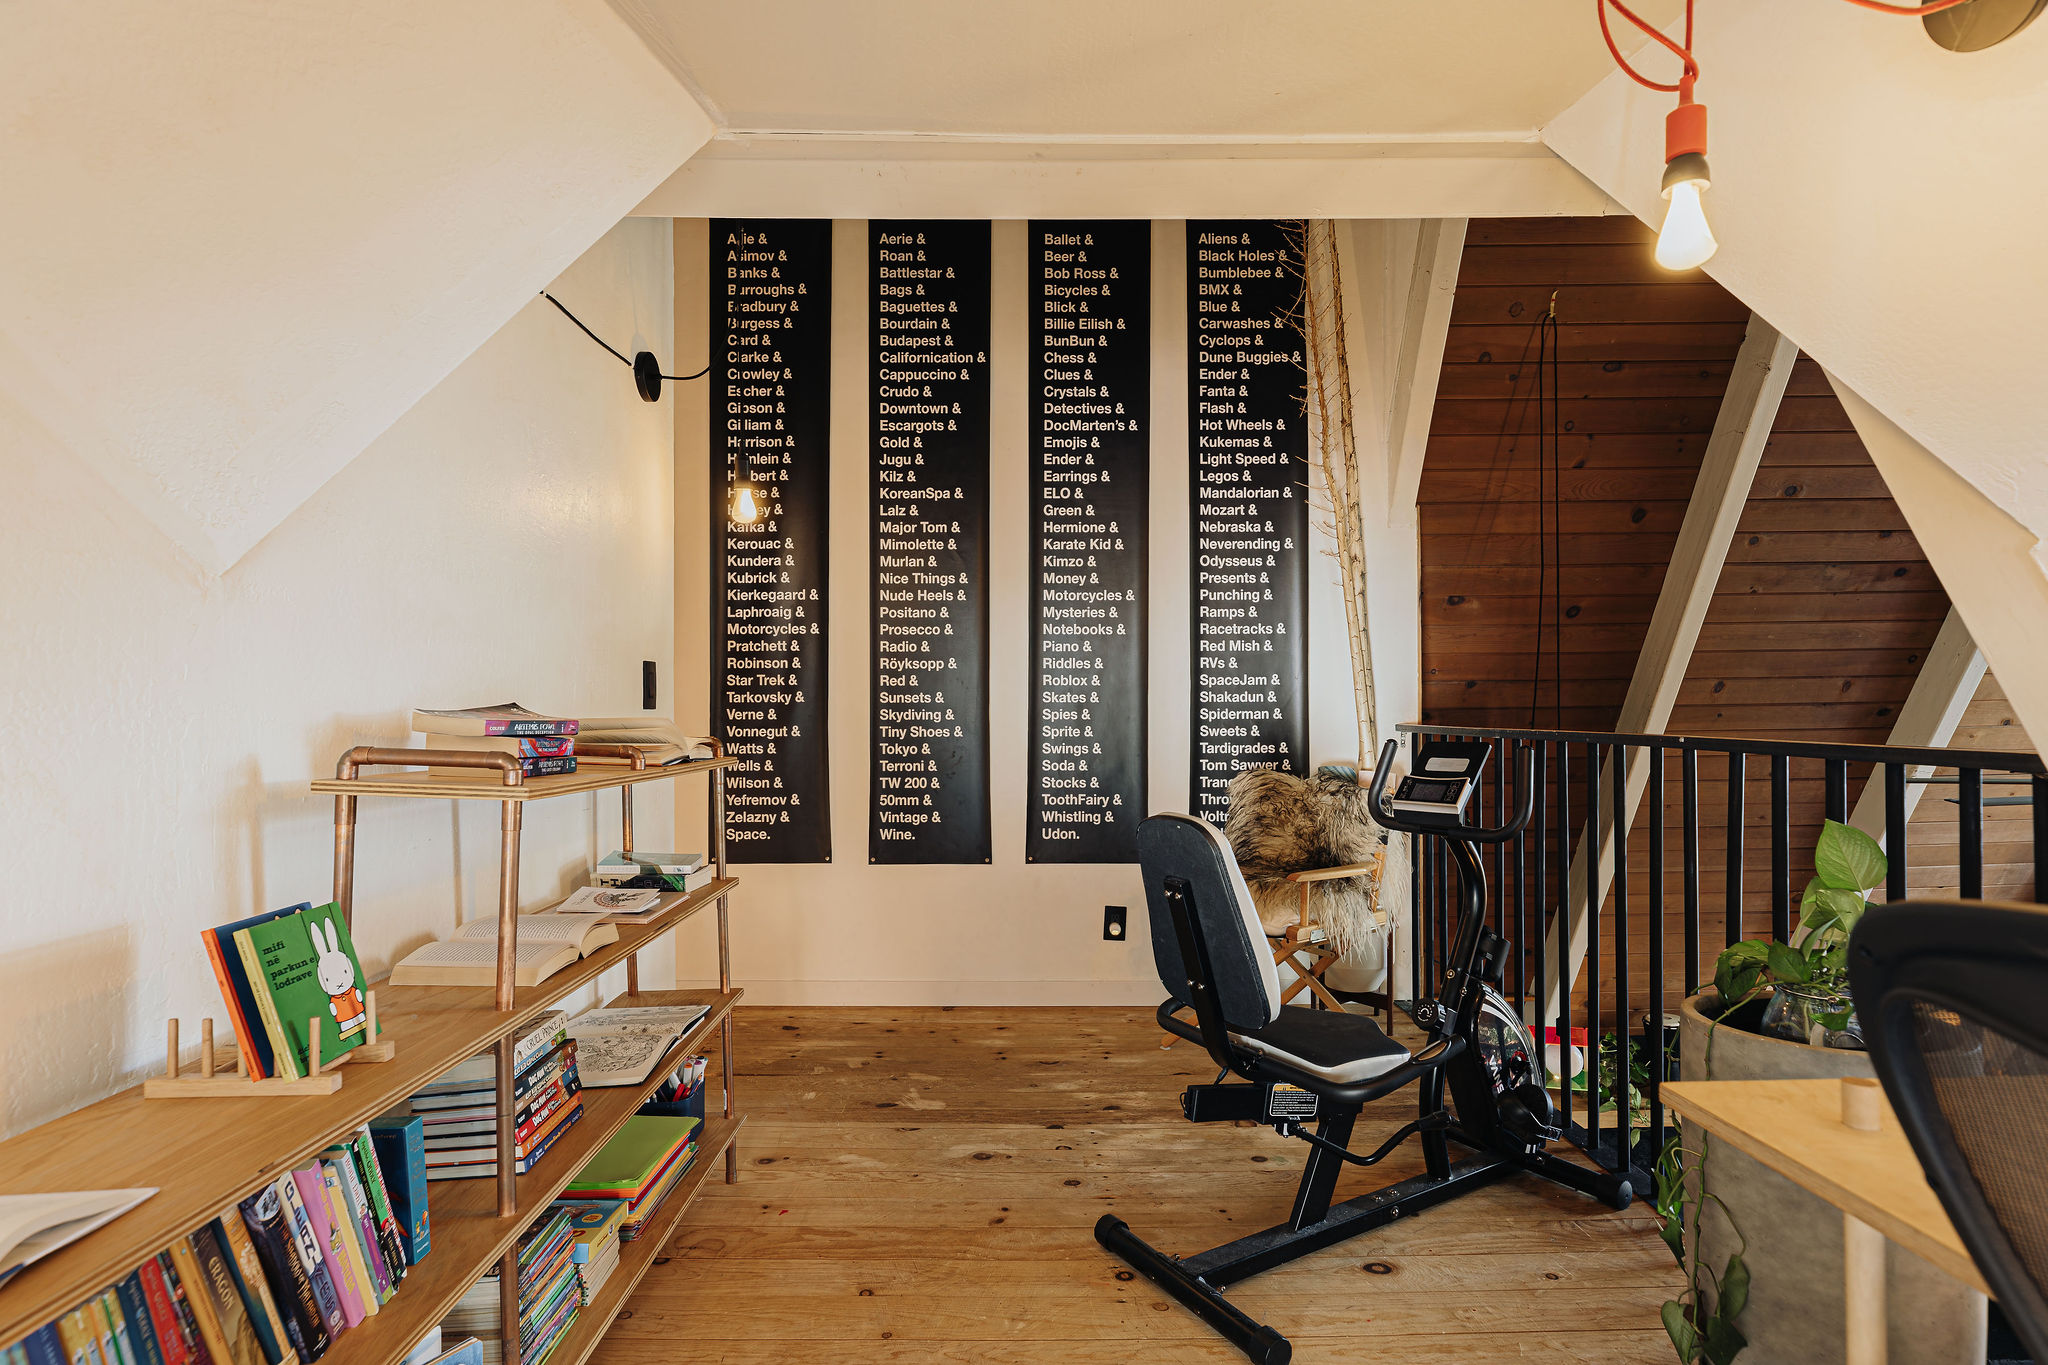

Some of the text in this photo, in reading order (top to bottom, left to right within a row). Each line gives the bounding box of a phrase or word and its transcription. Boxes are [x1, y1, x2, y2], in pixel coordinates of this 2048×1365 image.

[880, 233, 926, 244] Aerie &
[1045, 234, 1093, 245] Ballet &
[1199, 233, 1250, 244] Aliens &
[771, 267, 780, 278] &
[880, 267, 955, 278] Battlestar &
[1045, 268, 1119, 279] Bob Ross &
[1200, 284, 1242, 295] BMX &
[880, 301, 958, 314] Baguettes &
[1045, 318, 1126, 329] Billie Eilish &
[1199, 335, 1264, 348] Cyclops &
[880, 352, 986, 363] Californication &
[1200, 351, 1302, 365] Dune Buggies &
[783, 368, 792, 379] &
[776, 385, 784, 396] &
[1044, 386, 1109, 399] Crystals &
[880, 403, 961, 414] Downtown &
[1044, 403, 1125, 414] Detectives &
[1200, 419, 1285, 430] Hot Wheels &
[1200, 436, 1272, 447] Kukemas &
[879, 454, 924, 467] Jugu &
[880, 487, 963, 501] KoreanSpa &
[1044, 488, 1084, 499] ELO &
[1200, 487, 1292, 498] Mandalorian &
[728, 538, 794, 549] Kerouac &
[880, 539, 957, 550] Mimolette &
[1044, 539, 1124, 550] Karate Kid &
[1200, 555, 1275, 569] Odysseus &
[728, 572, 790, 583] Kubrick &
[880, 573, 968, 586] Nice Things &
[728, 589, 818, 602] Kierkegaard &
[1044, 607, 1118, 620] Mysteries &
[728, 623, 819, 636] Motorcycles &
[881, 658, 957, 671] Röyksopp &
[1201, 657, 1238, 668] RVs &
[727, 674, 797, 686] Star Trek &
[1043, 675, 1100, 686] Roblox &
[727, 691, 805, 705] Tarkovsky &
[1200, 691, 1277, 702] Shakadun &
[880, 709, 954, 722] Skydiving &
[727, 725, 801, 739] Vonnegut &
[1042, 726, 1093, 739] Sprite &
[1200, 759, 1227, 770] Tom
[1282, 759, 1291, 770] &
[726, 777, 783, 788] Wilson &
[880, 777, 940, 788] TW 200 &
[1042, 794, 1122, 807] ToothFairy &
[726, 811, 790, 825] Zelazny &
[1200, 811, 1229, 822] Voltr
[726, 829, 770, 842] Space.
[880, 829, 915, 840] Wine.
[1042, 828, 1079, 839] Udon.
[262, 940, 286, 955] mifi
[266, 955, 280, 968] në
[270, 956, 315, 981] parkun e
[273, 970, 313, 991] lodrave
[208, 1256, 235, 1311] ERAGON
